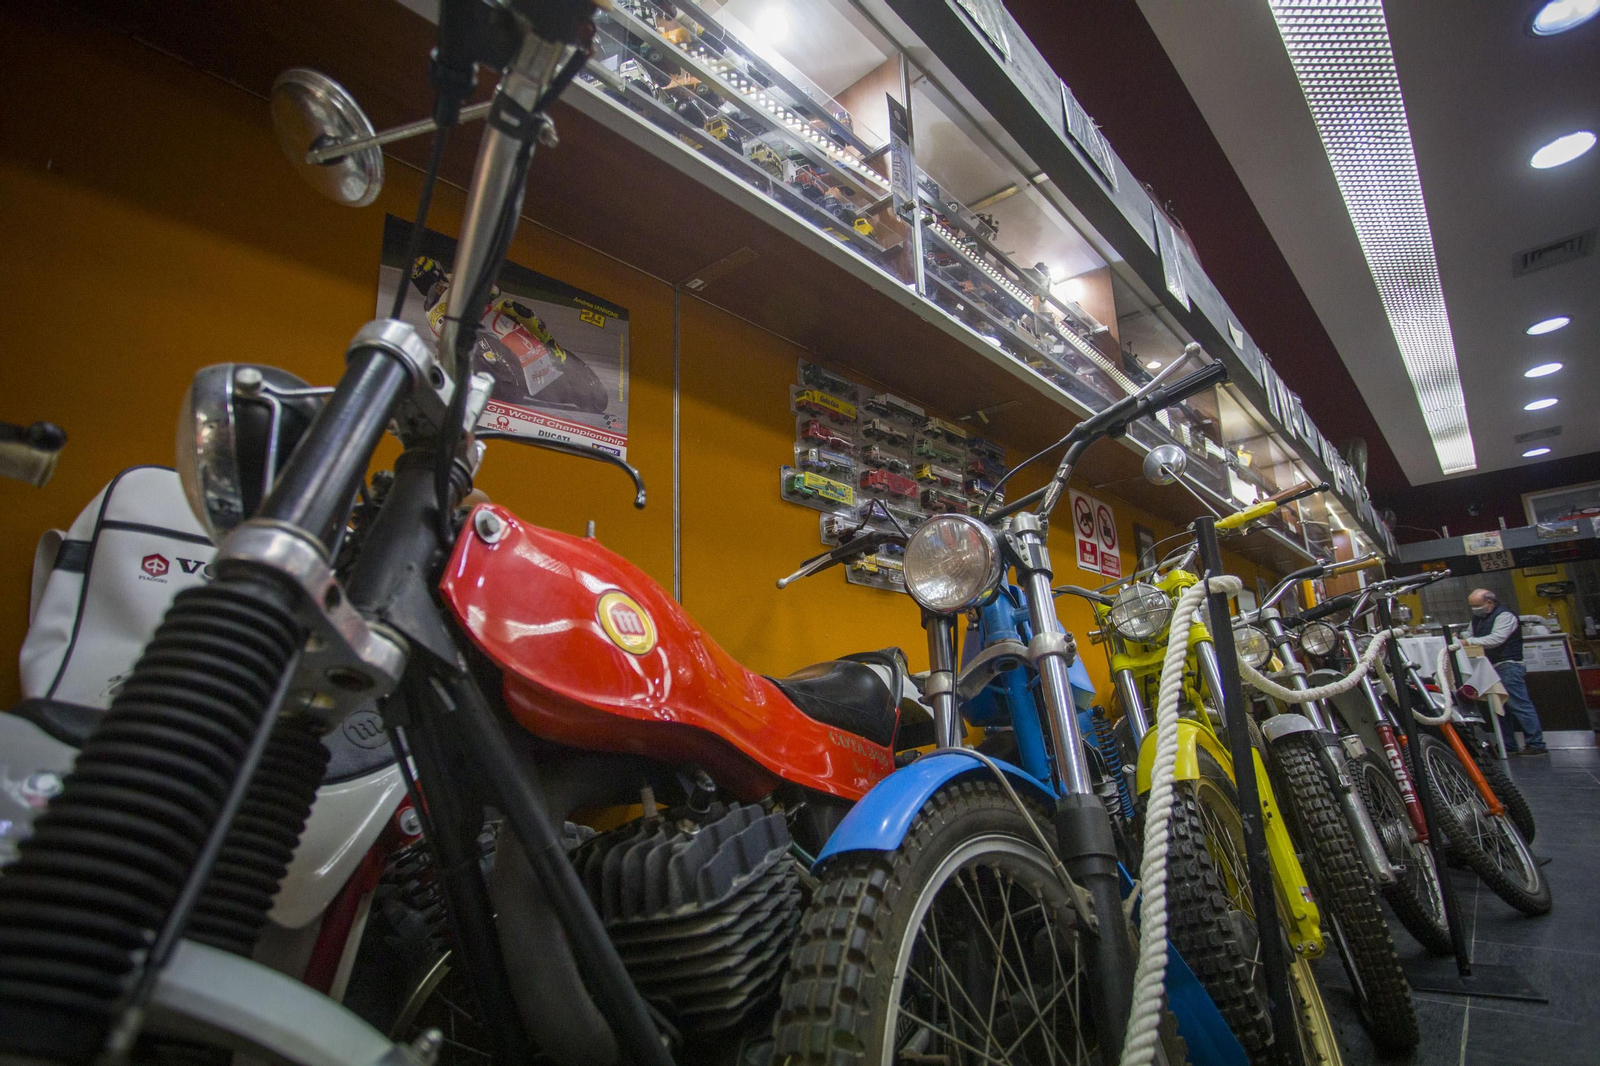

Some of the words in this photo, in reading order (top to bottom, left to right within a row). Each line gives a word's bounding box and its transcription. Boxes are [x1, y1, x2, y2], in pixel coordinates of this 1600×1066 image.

[573, 297, 594, 308] Andrea
[594, 304, 620, 319] IANNONE
[580, 308, 606, 329] 29
[486, 404, 506, 414] Gp
[509, 411, 545, 425] World
[546, 420, 625, 446] Championship
[538, 430, 571, 442] DUCATI
[1484, 559, 1509, 570] 259
[138, 575, 168, 584] PIAGGIO
